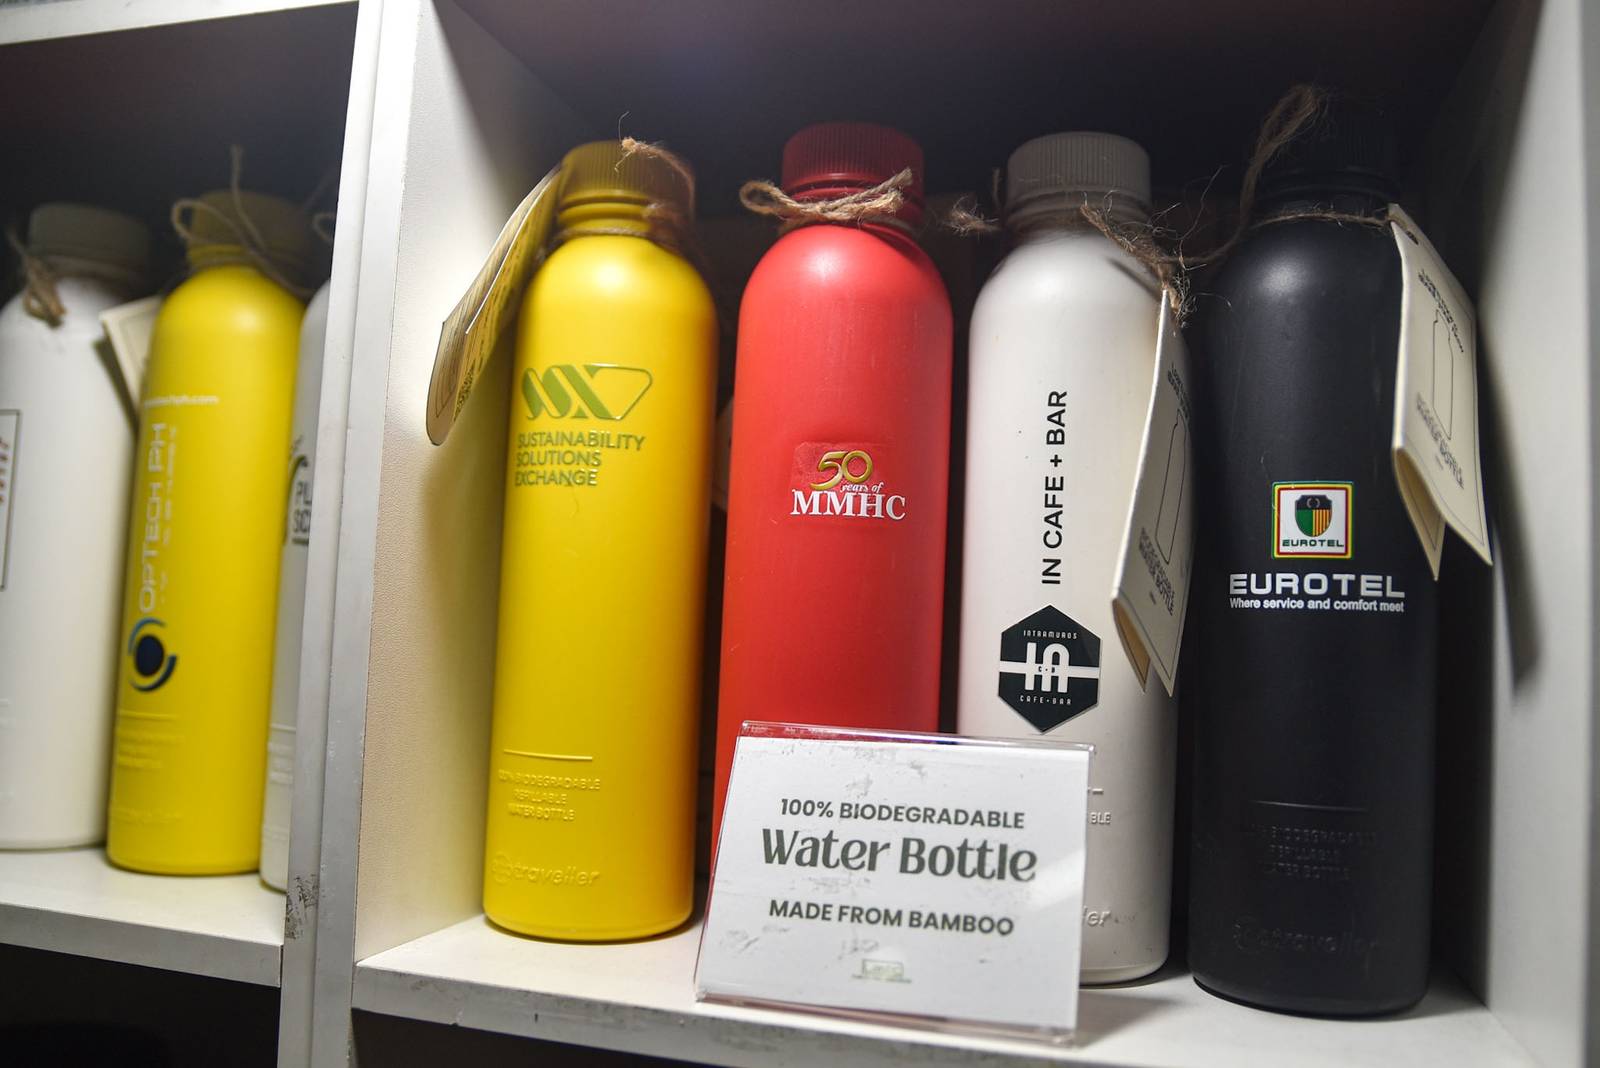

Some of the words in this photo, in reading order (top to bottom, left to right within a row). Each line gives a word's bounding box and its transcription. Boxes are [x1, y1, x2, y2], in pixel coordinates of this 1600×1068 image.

[1046, 391, 1068, 445] BAR
[517, 430, 646, 451] SUSTAINABILITY
[515, 449, 602, 467] SOLUTIONS
[809, 450, 873, 491] 50
[1050, 454, 1062, 467] +
[514, 468, 599, 486] EXCHANGE
[840, 484, 868, 493] years
[871, 482, 884, 493] of
[790, 489, 906, 520] MMHC
[1043, 476, 1064, 549] CAFE
[1282, 539, 1345, 547] EUROTEL
[1042, 558, 1062, 585] IN
[1229, 573, 1406, 598] EUROTEL
[1230, 598, 1260, 609] Where
[1263, 598, 1304, 609] service
[1307, 598, 1330, 610] and
[1333, 599, 1377, 612] comfort
[1380, 600, 1404, 612] meet
[781, 798, 834, 818] 100%
[839, 802, 1025, 829] BIODEGRADABLE
[762, 828, 891, 872] Water
[899, 837, 1038, 883] Bottle
[769, 899, 833, 921] MADE
[838, 905, 903, 927] FROM
[908, 911, 1015, 936] BAMBOO
